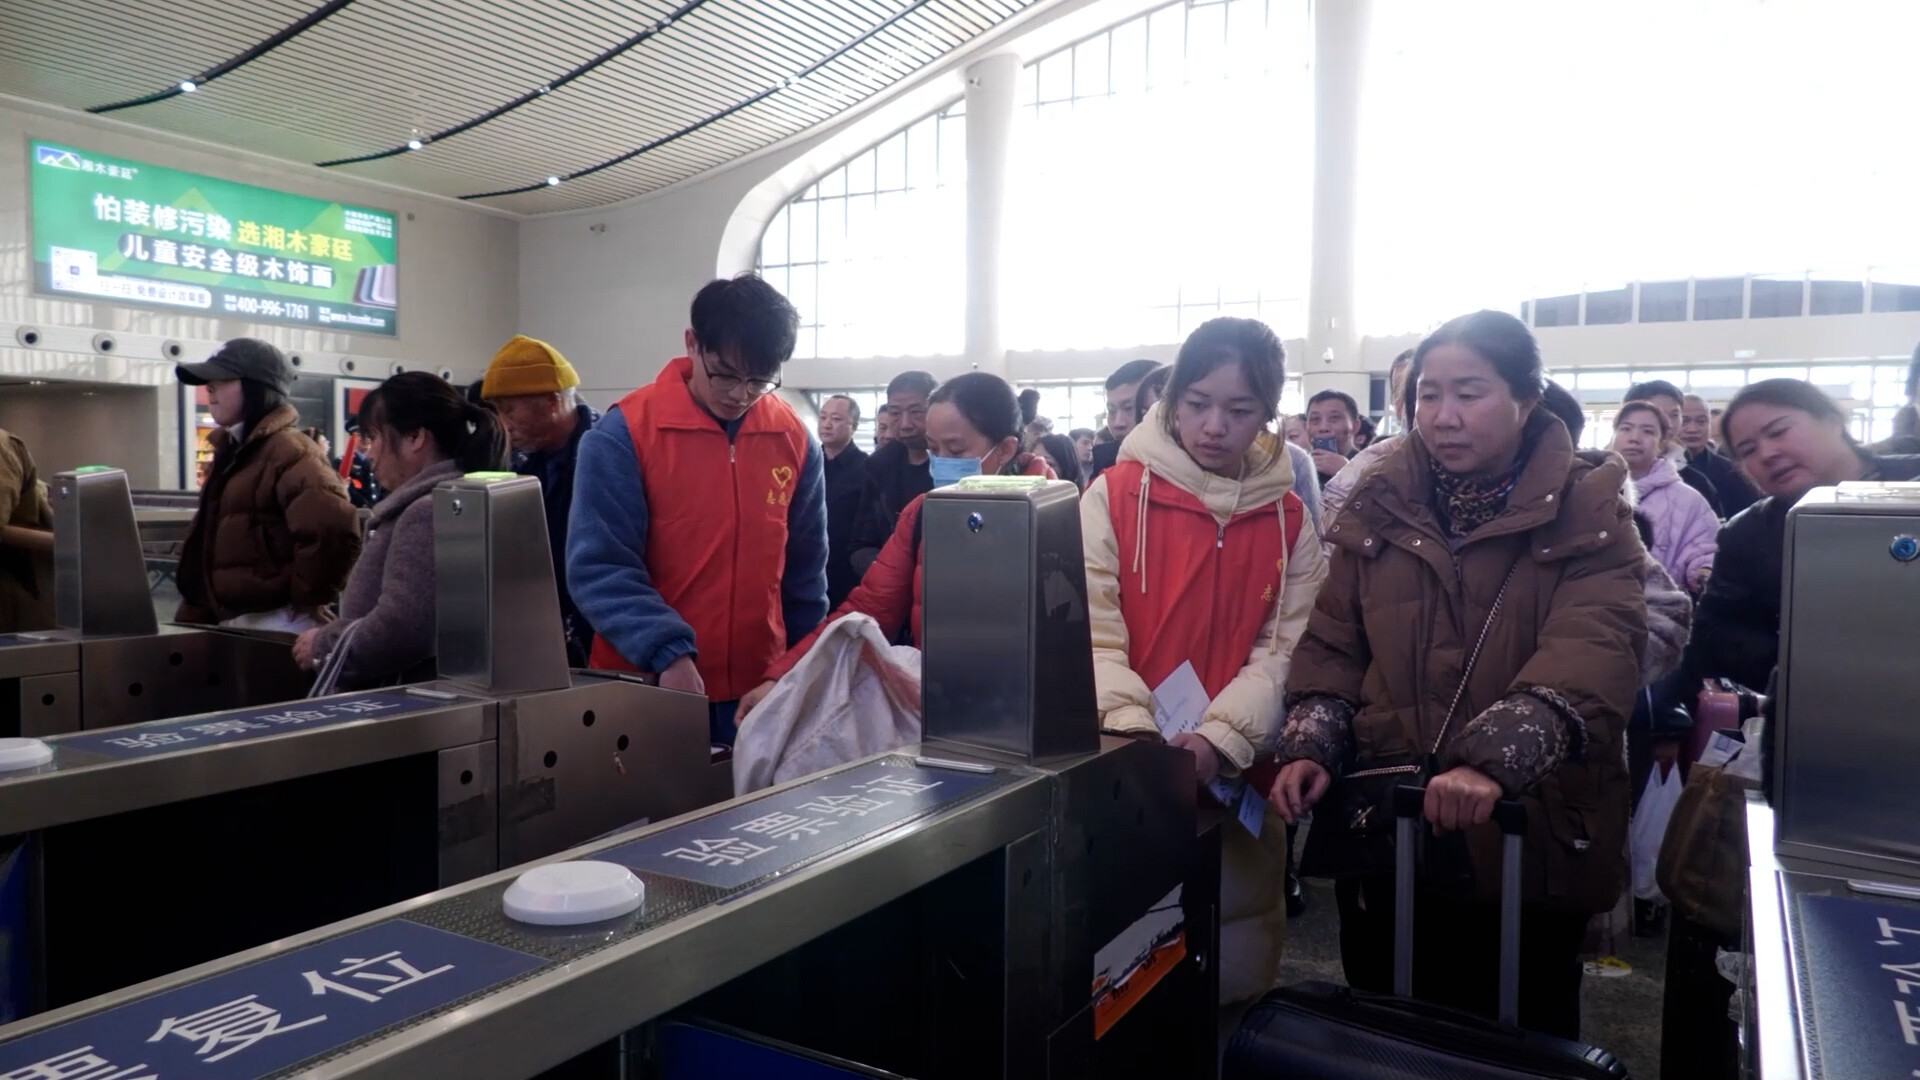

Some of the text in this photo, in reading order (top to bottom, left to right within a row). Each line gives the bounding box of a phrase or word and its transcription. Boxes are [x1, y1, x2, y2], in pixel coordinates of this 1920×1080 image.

[94, 192, 231, 241] 怕装修污染
[124, 234, 332, 288] 儿童安全级木饰面
[104, 699, 400, 748] 验票验证
[661, 775, 944, 866] 验票验证
